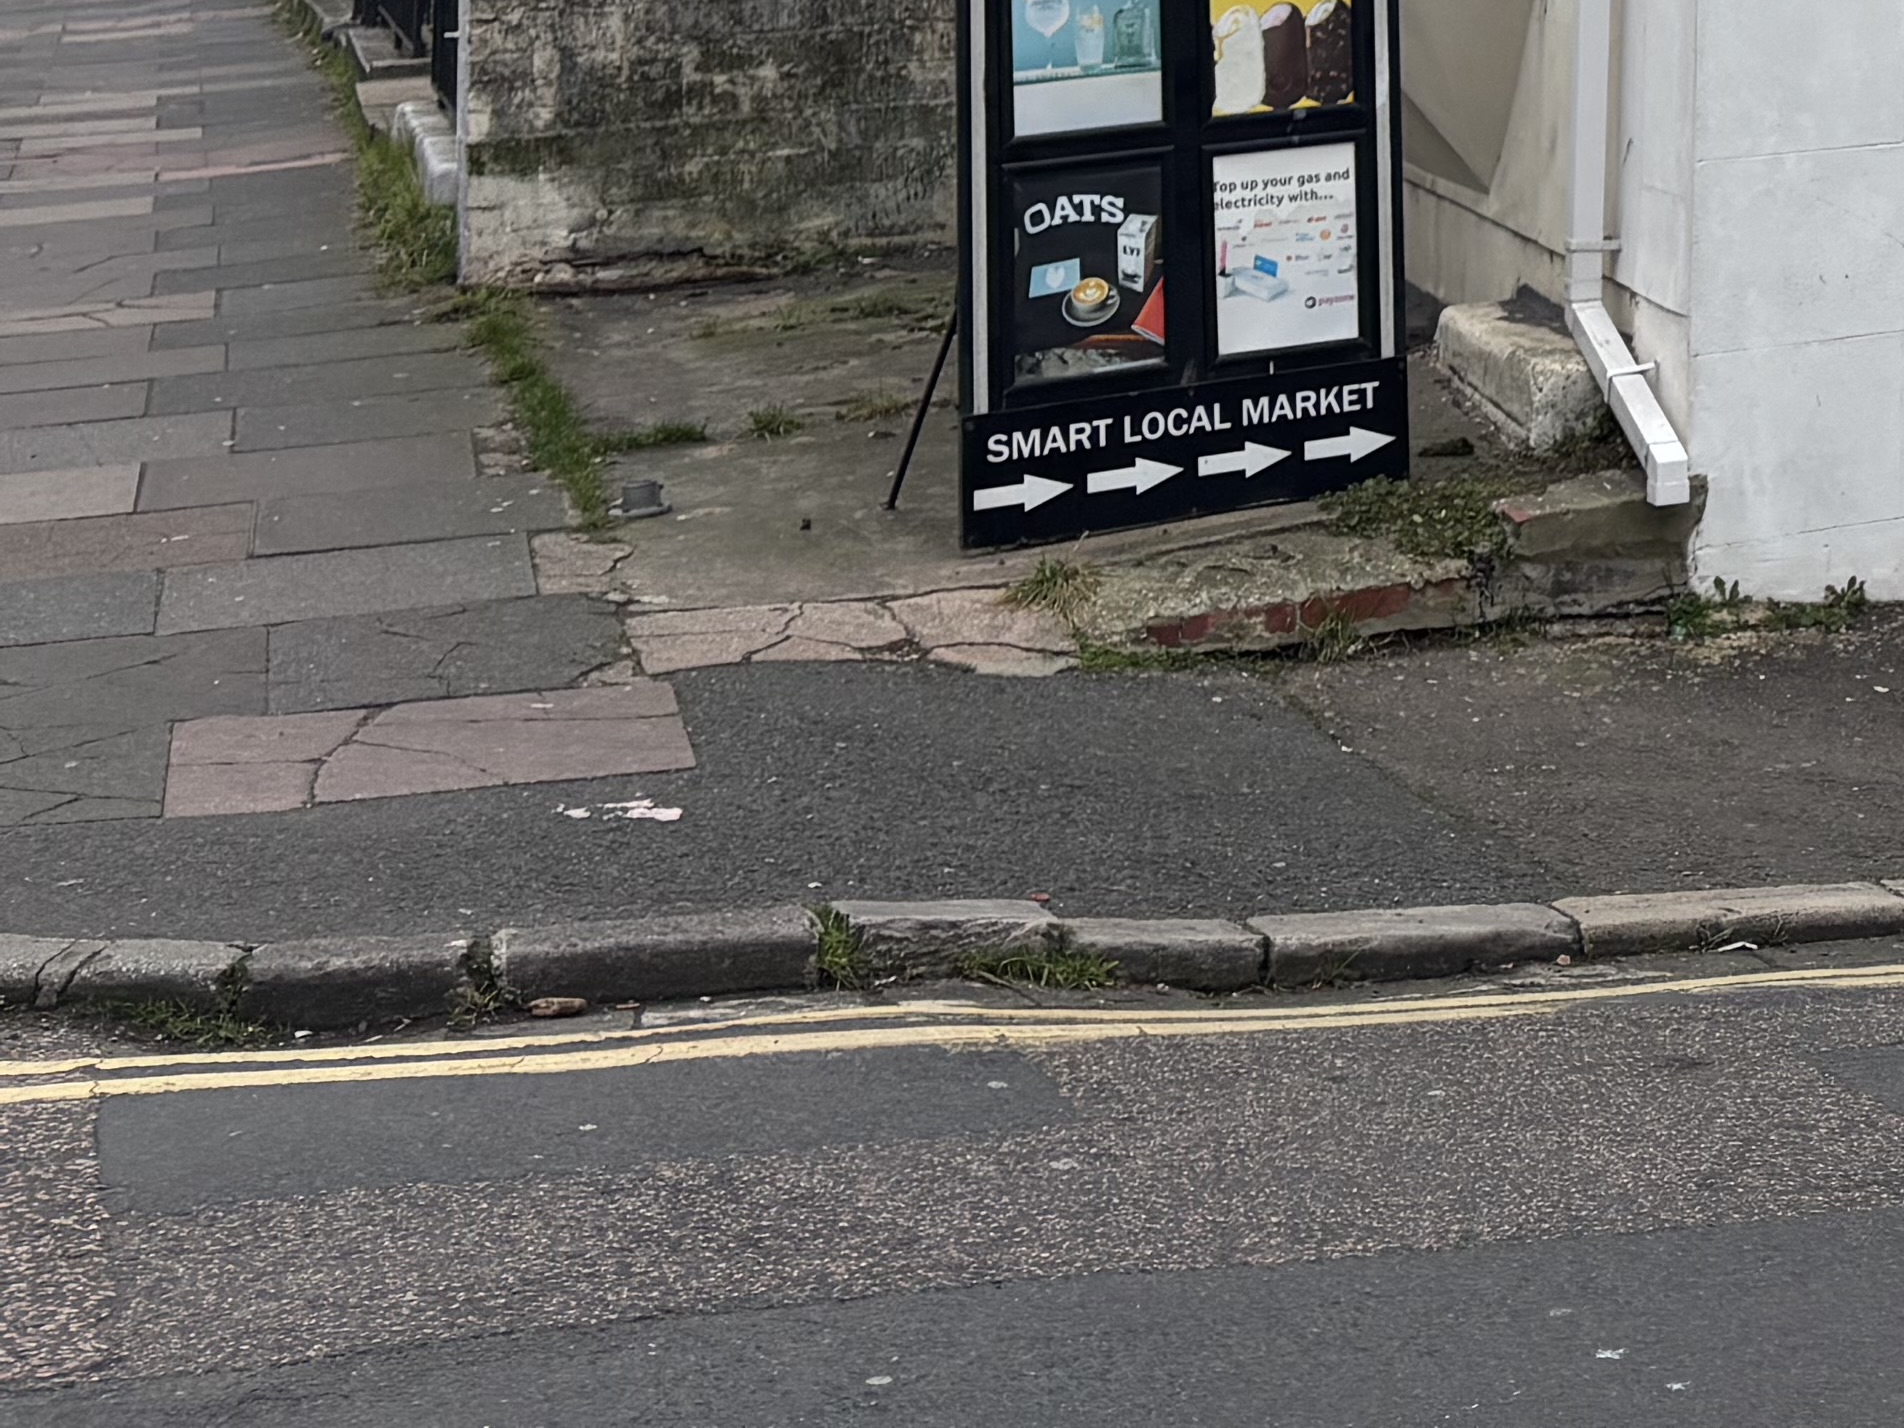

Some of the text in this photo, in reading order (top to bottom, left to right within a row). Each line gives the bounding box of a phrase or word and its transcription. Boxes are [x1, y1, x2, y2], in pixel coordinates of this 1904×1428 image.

[1240, 178, 1259, 192] up
[1262, 174, 1294, 191] your
[1297, 172, 1321, 187] gas
[1324, 167, 1350, 182] and
[1023, 193, 1125, 234] OATS
[986, 380, 1381, 463] SMART LOCAL MARKET
